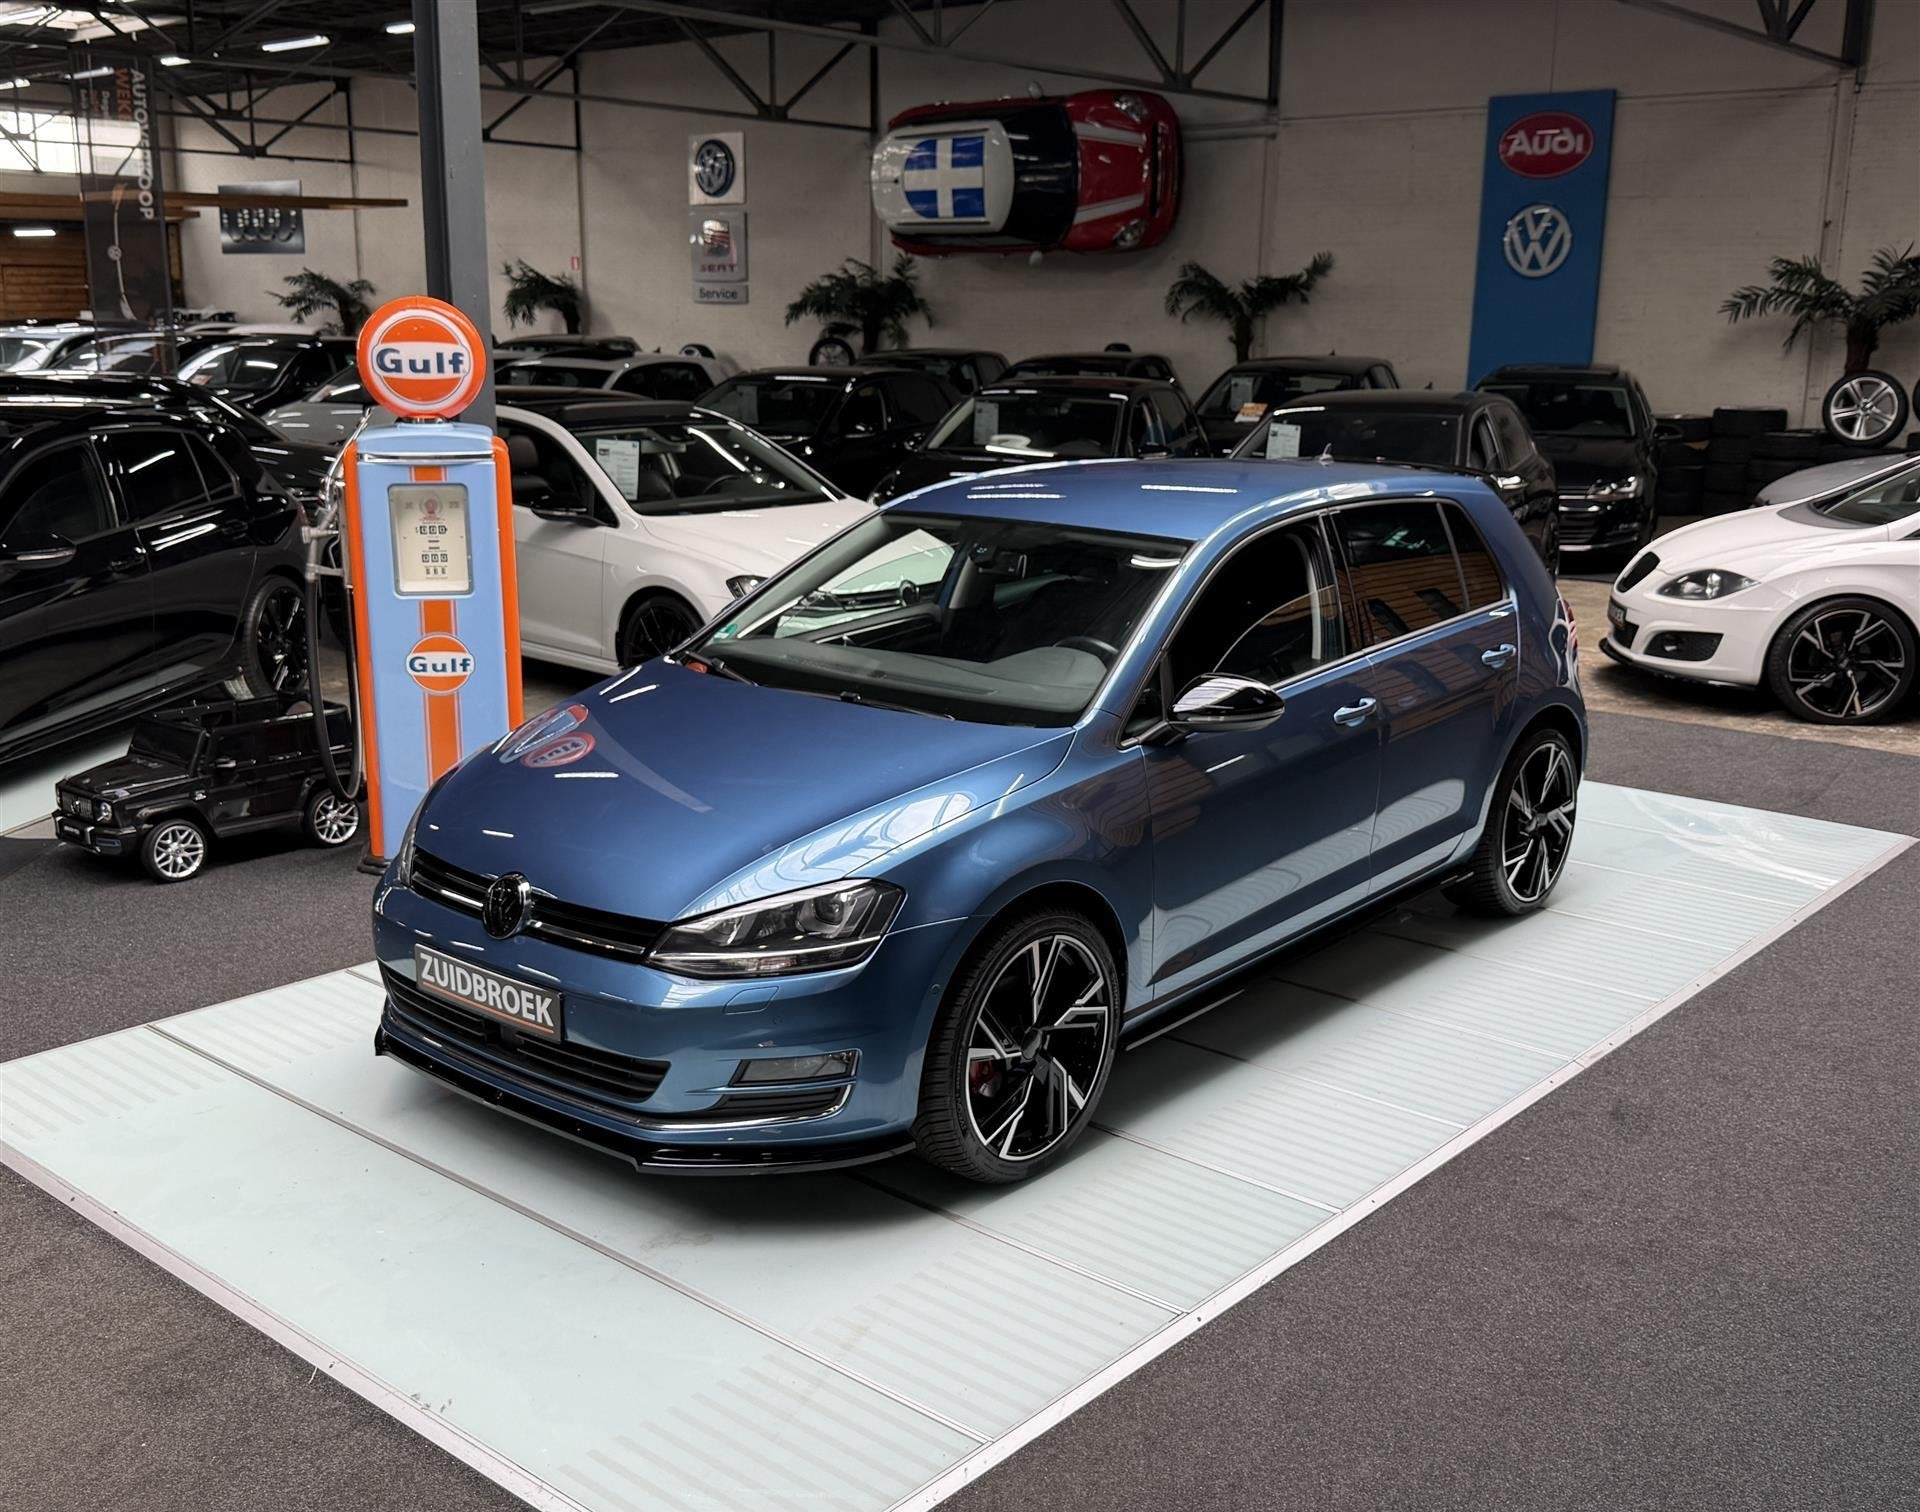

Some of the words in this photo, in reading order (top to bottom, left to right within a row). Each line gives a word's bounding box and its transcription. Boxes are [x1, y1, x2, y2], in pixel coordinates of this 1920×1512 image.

[700, 287, 738, 299] Service
[376, 347, 464, 374] Gulf
[409, 656, 471, 673] Gulf
[420, 952, 554, 1028] ZUIDBROEK
